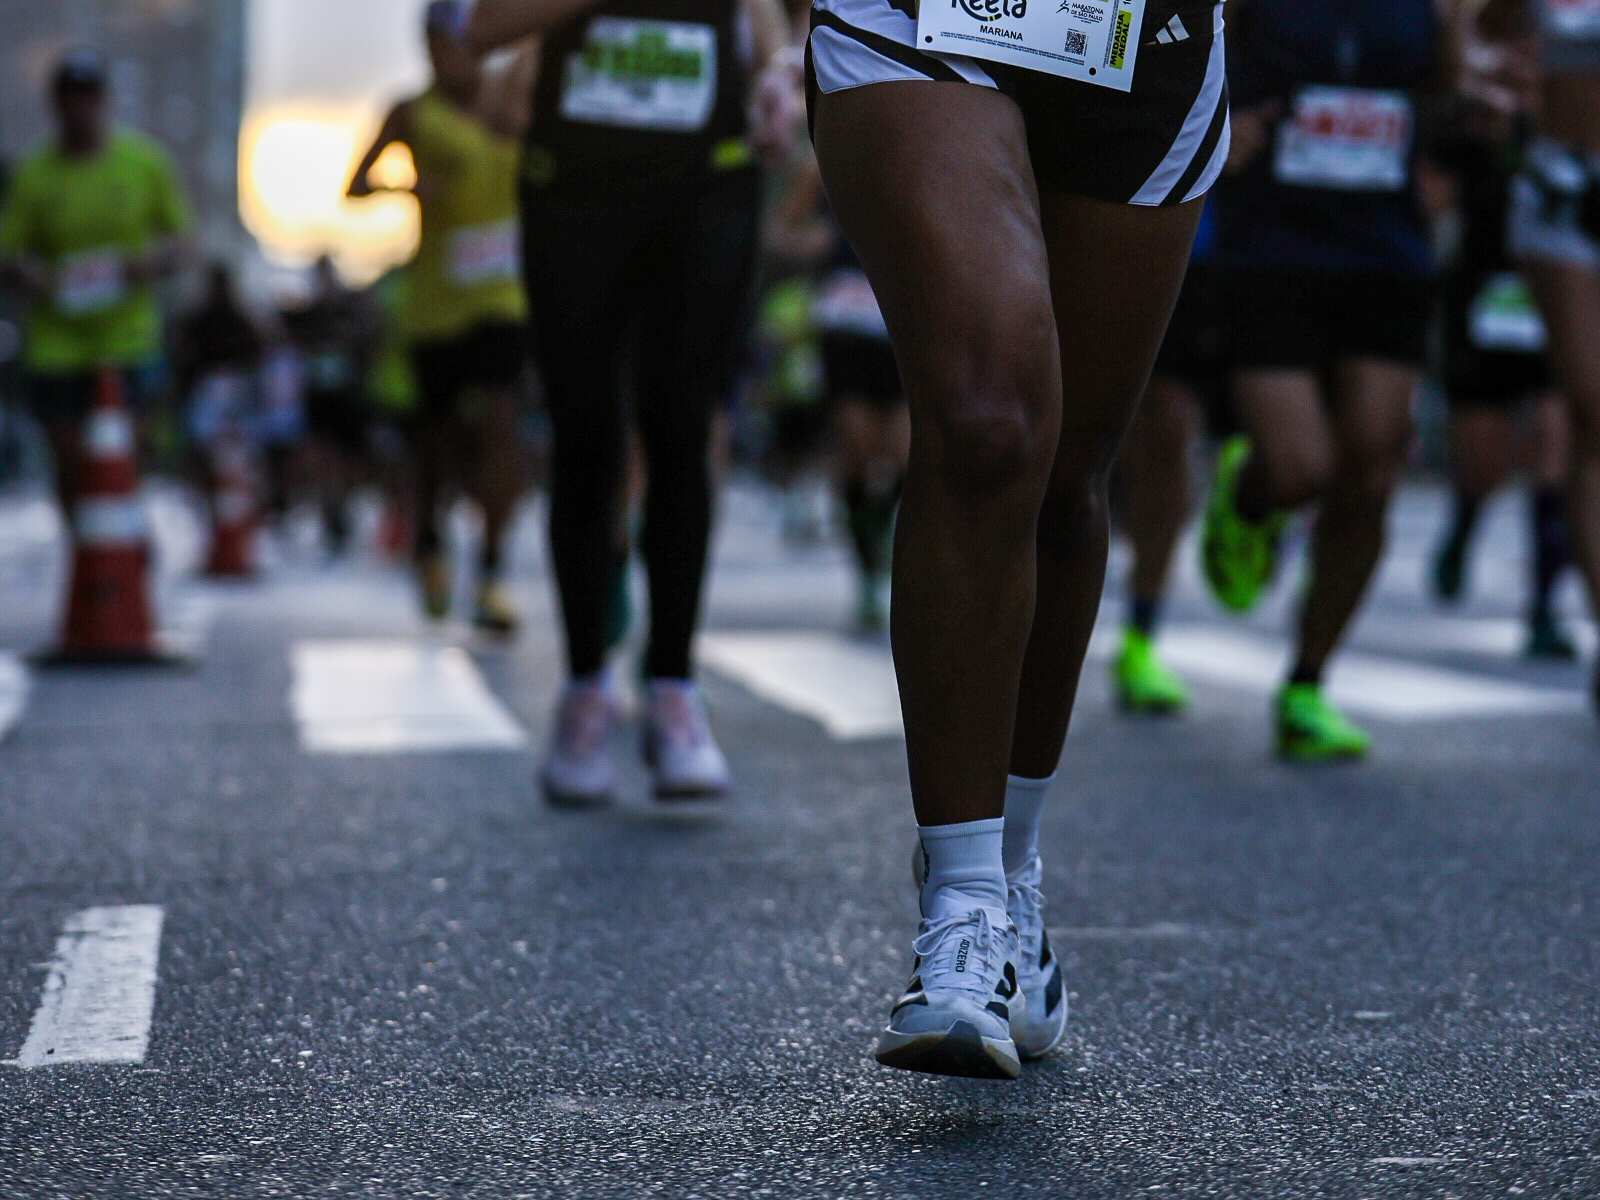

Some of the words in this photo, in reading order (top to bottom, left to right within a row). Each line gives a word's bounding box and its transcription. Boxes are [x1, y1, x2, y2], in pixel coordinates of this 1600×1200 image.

[1071, 2, 1104, 15] MARATONA
[979, 24, 1024, 42] MARIANA
[1109, 13, 1125, 66] MEDALHA
[1117, 22, 1130, 60] MEDAL
[955, 938, 971, 973] ADIZERO
